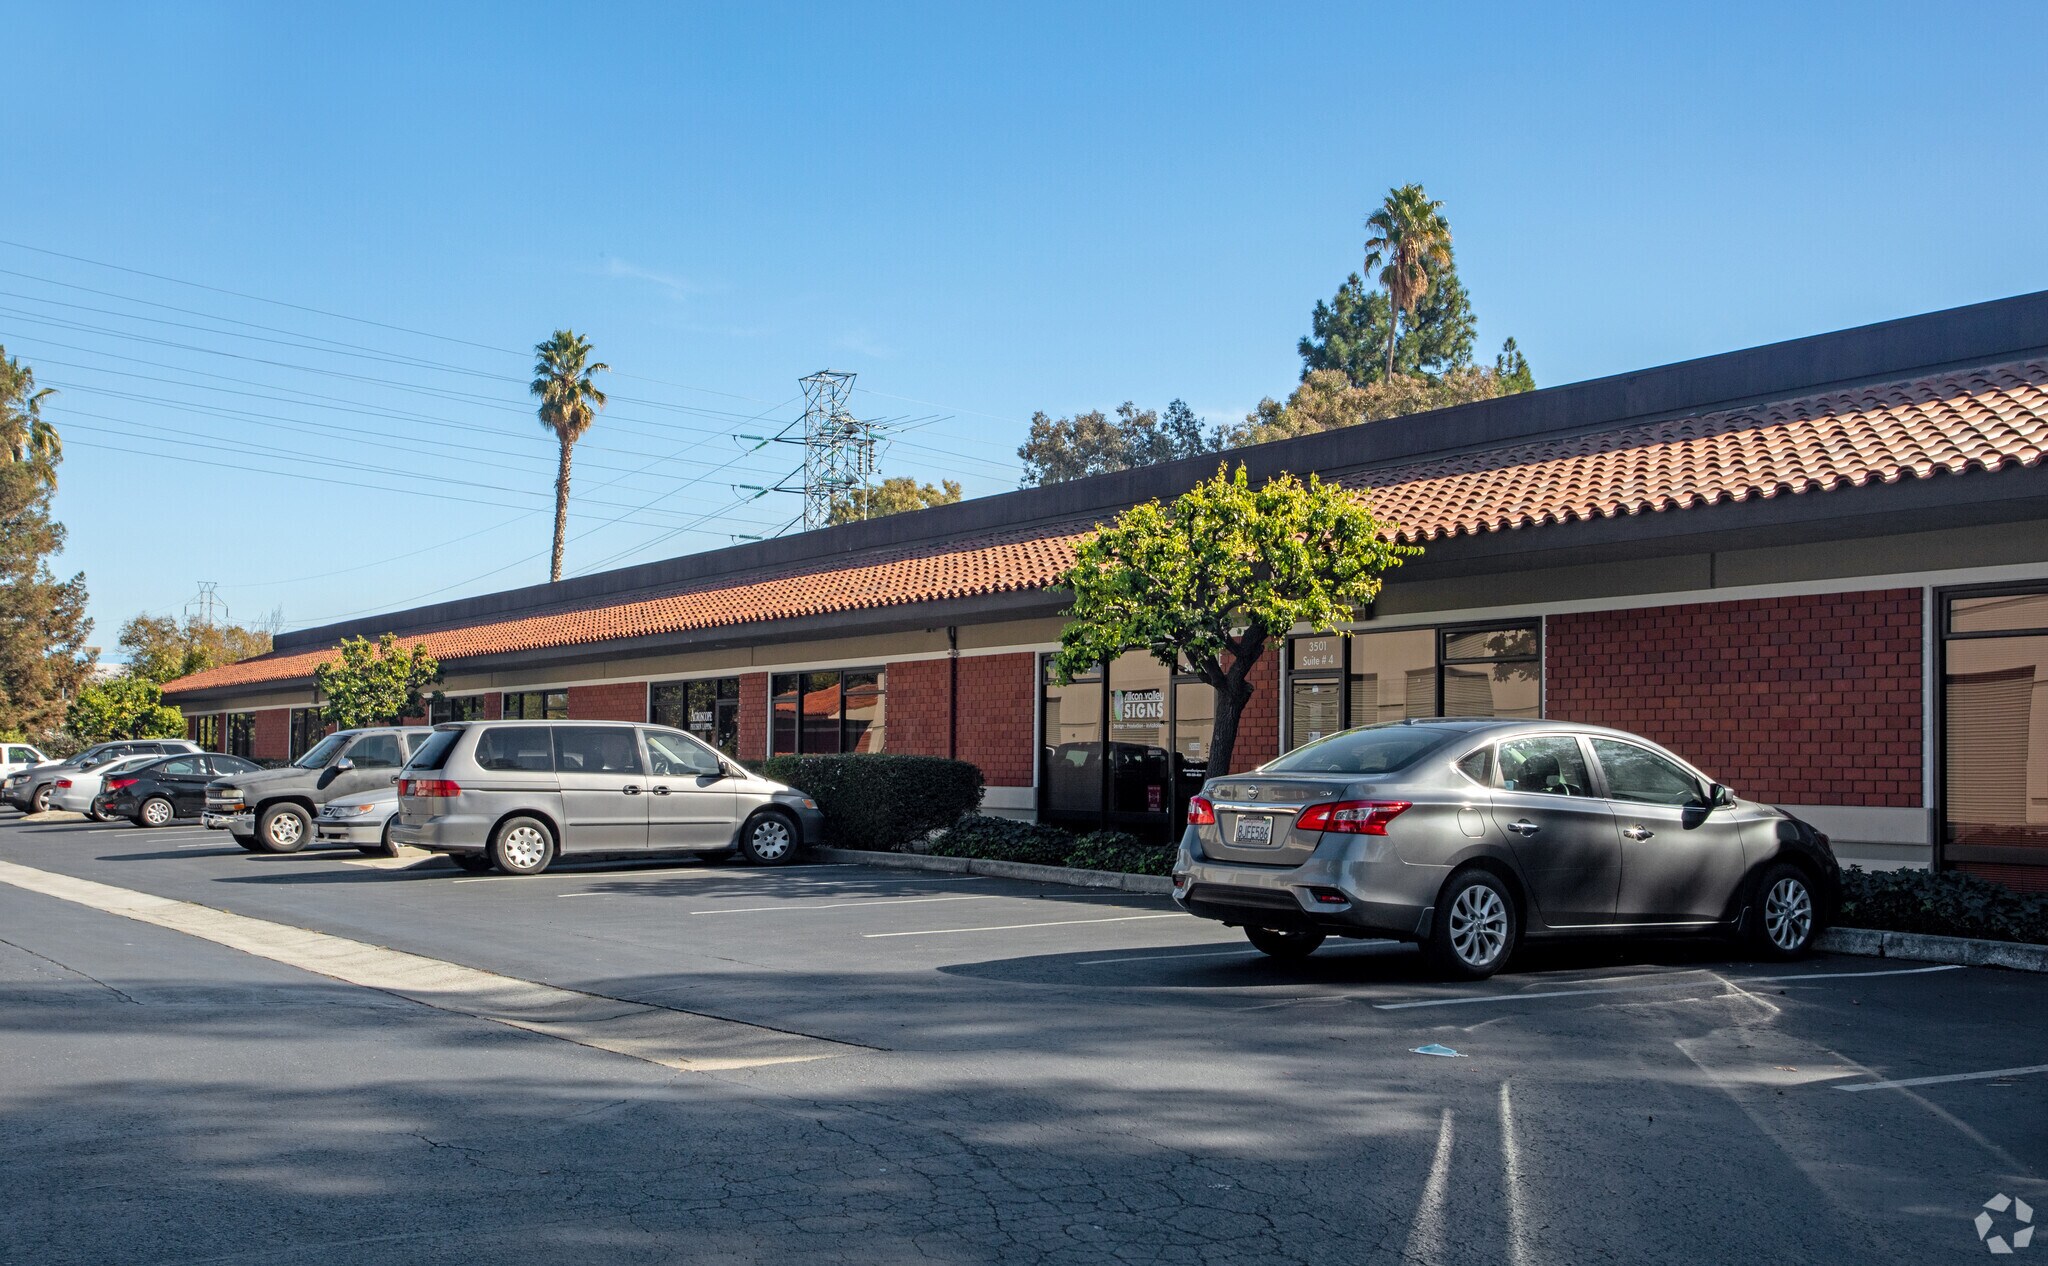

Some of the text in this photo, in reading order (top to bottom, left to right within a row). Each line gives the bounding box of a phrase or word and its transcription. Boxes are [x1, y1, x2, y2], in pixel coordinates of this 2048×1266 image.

[1308, 641, 1327, 652] 3501
[1303, 655, 1320, 666] Suite
[1124, 702, 1164, 718] SIGNS
